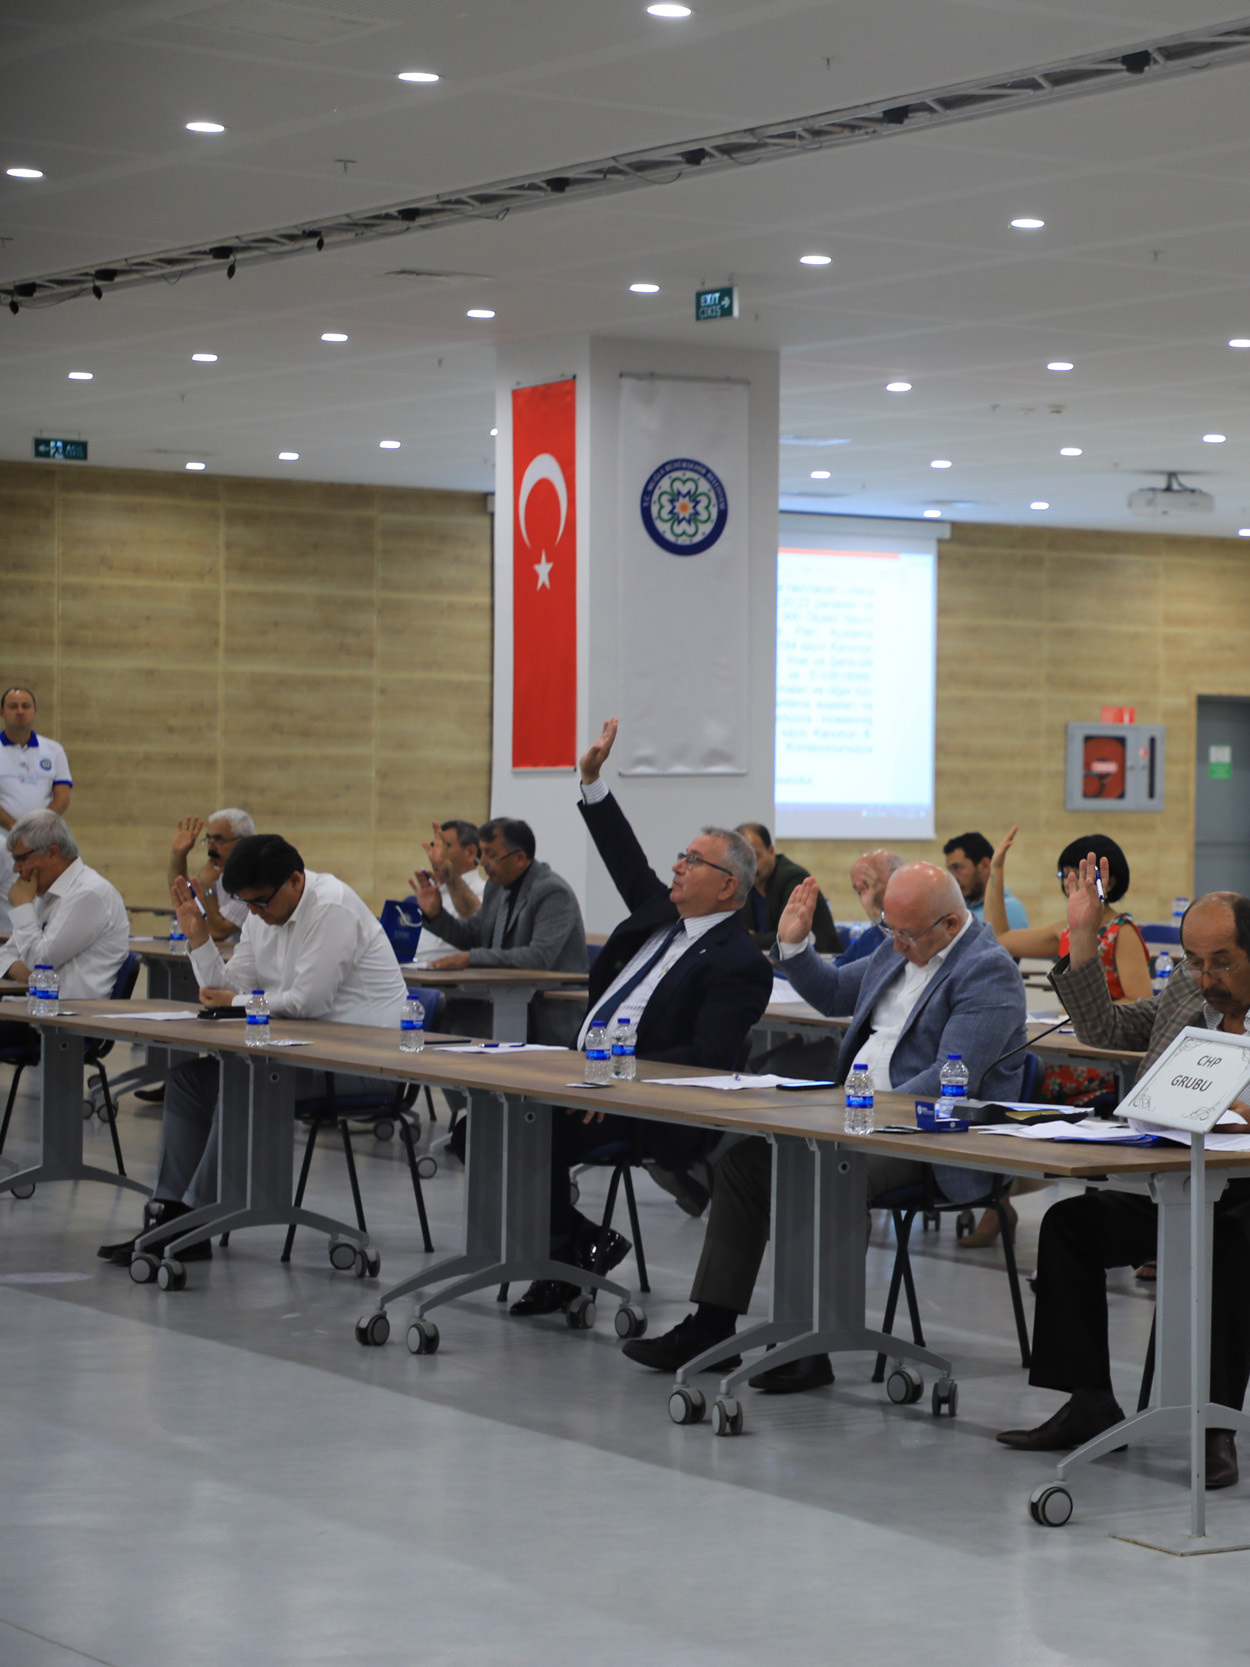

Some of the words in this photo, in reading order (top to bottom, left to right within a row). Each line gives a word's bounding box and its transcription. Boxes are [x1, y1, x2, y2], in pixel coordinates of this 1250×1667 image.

[700, 292, 721, 306] EXIT
[1196, 1055, 1222, 1068] CHP
[1170, 1074, 1213, 1092] GRUBU
